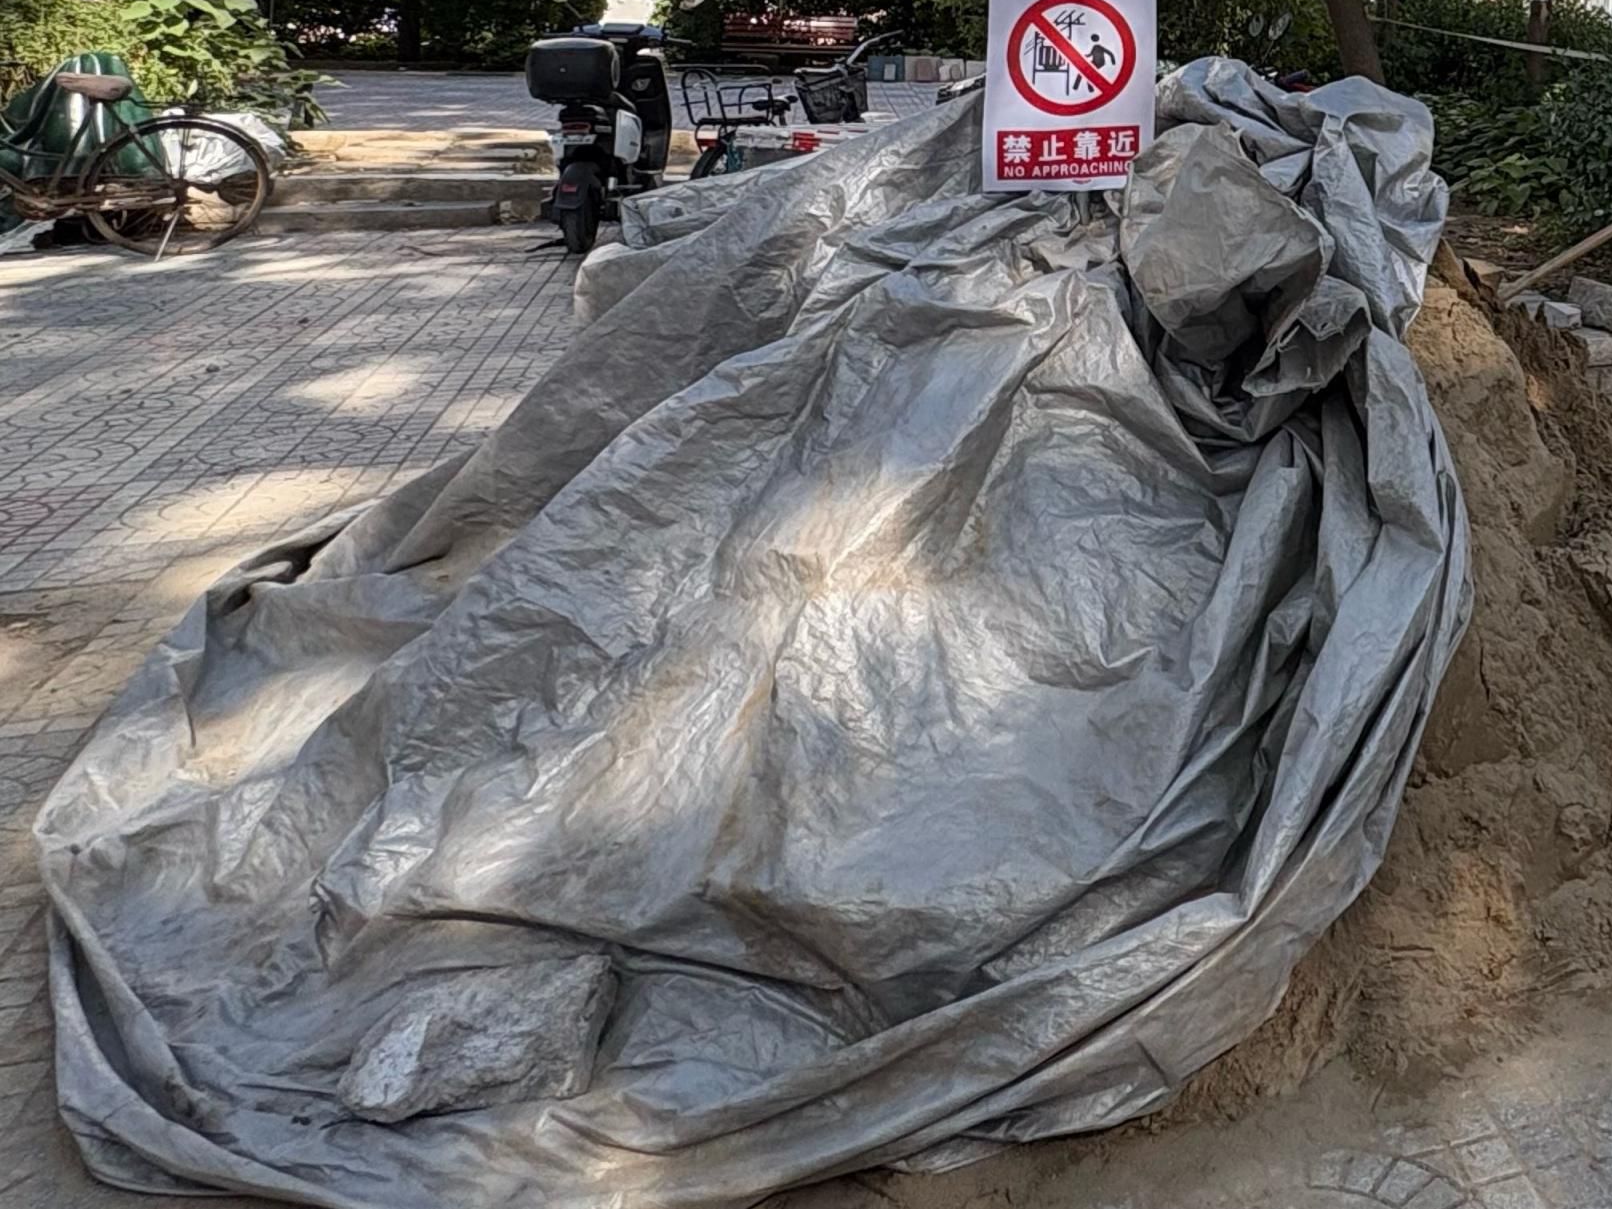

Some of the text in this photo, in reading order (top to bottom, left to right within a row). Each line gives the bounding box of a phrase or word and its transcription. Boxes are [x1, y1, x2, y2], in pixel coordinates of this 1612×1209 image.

[1003, 131, 1135, 163] 禁止靠近
[1004, 166, 1026, 177] NO
